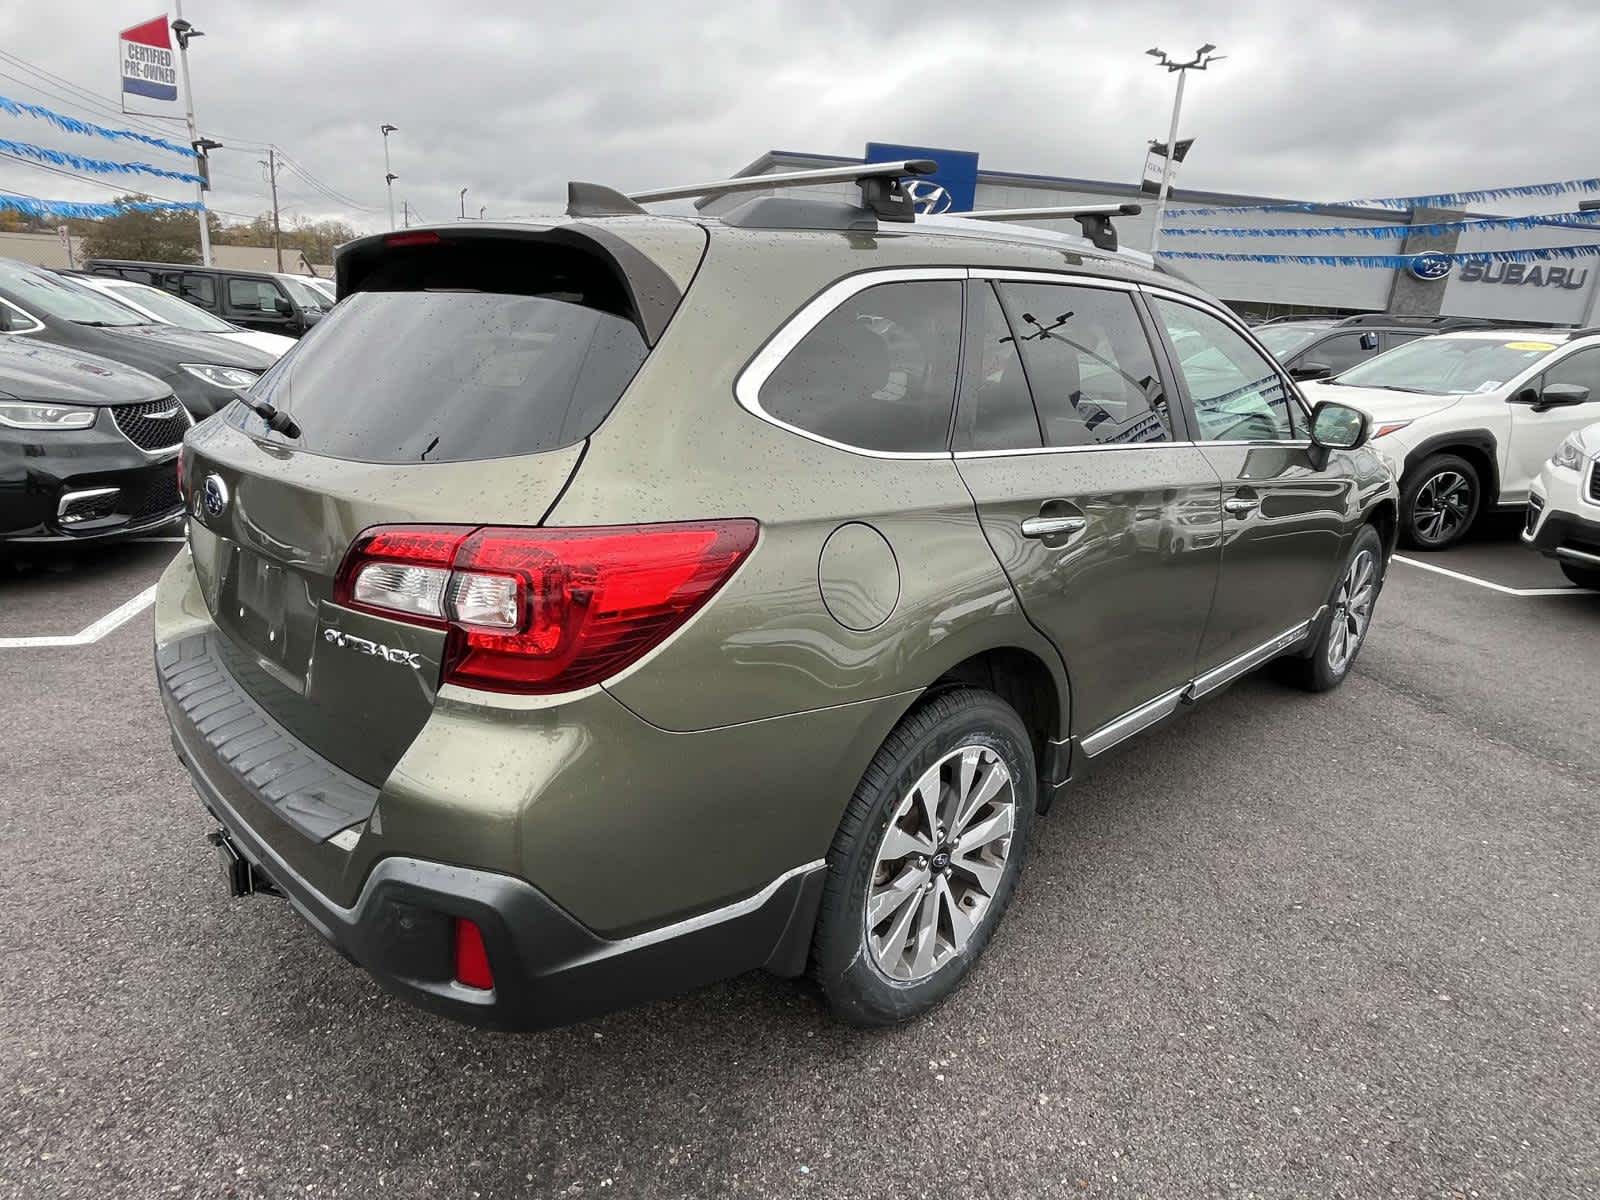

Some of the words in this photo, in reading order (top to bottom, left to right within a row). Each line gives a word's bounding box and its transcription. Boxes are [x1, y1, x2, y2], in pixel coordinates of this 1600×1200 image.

[128, 42, 172, 67] CERTIFIED
[124, 58, 176, 84] PRE-OWNED
[1459, 258, 1588, 290] SUBARU
[323, 628, 421, 669] OUTBACK
